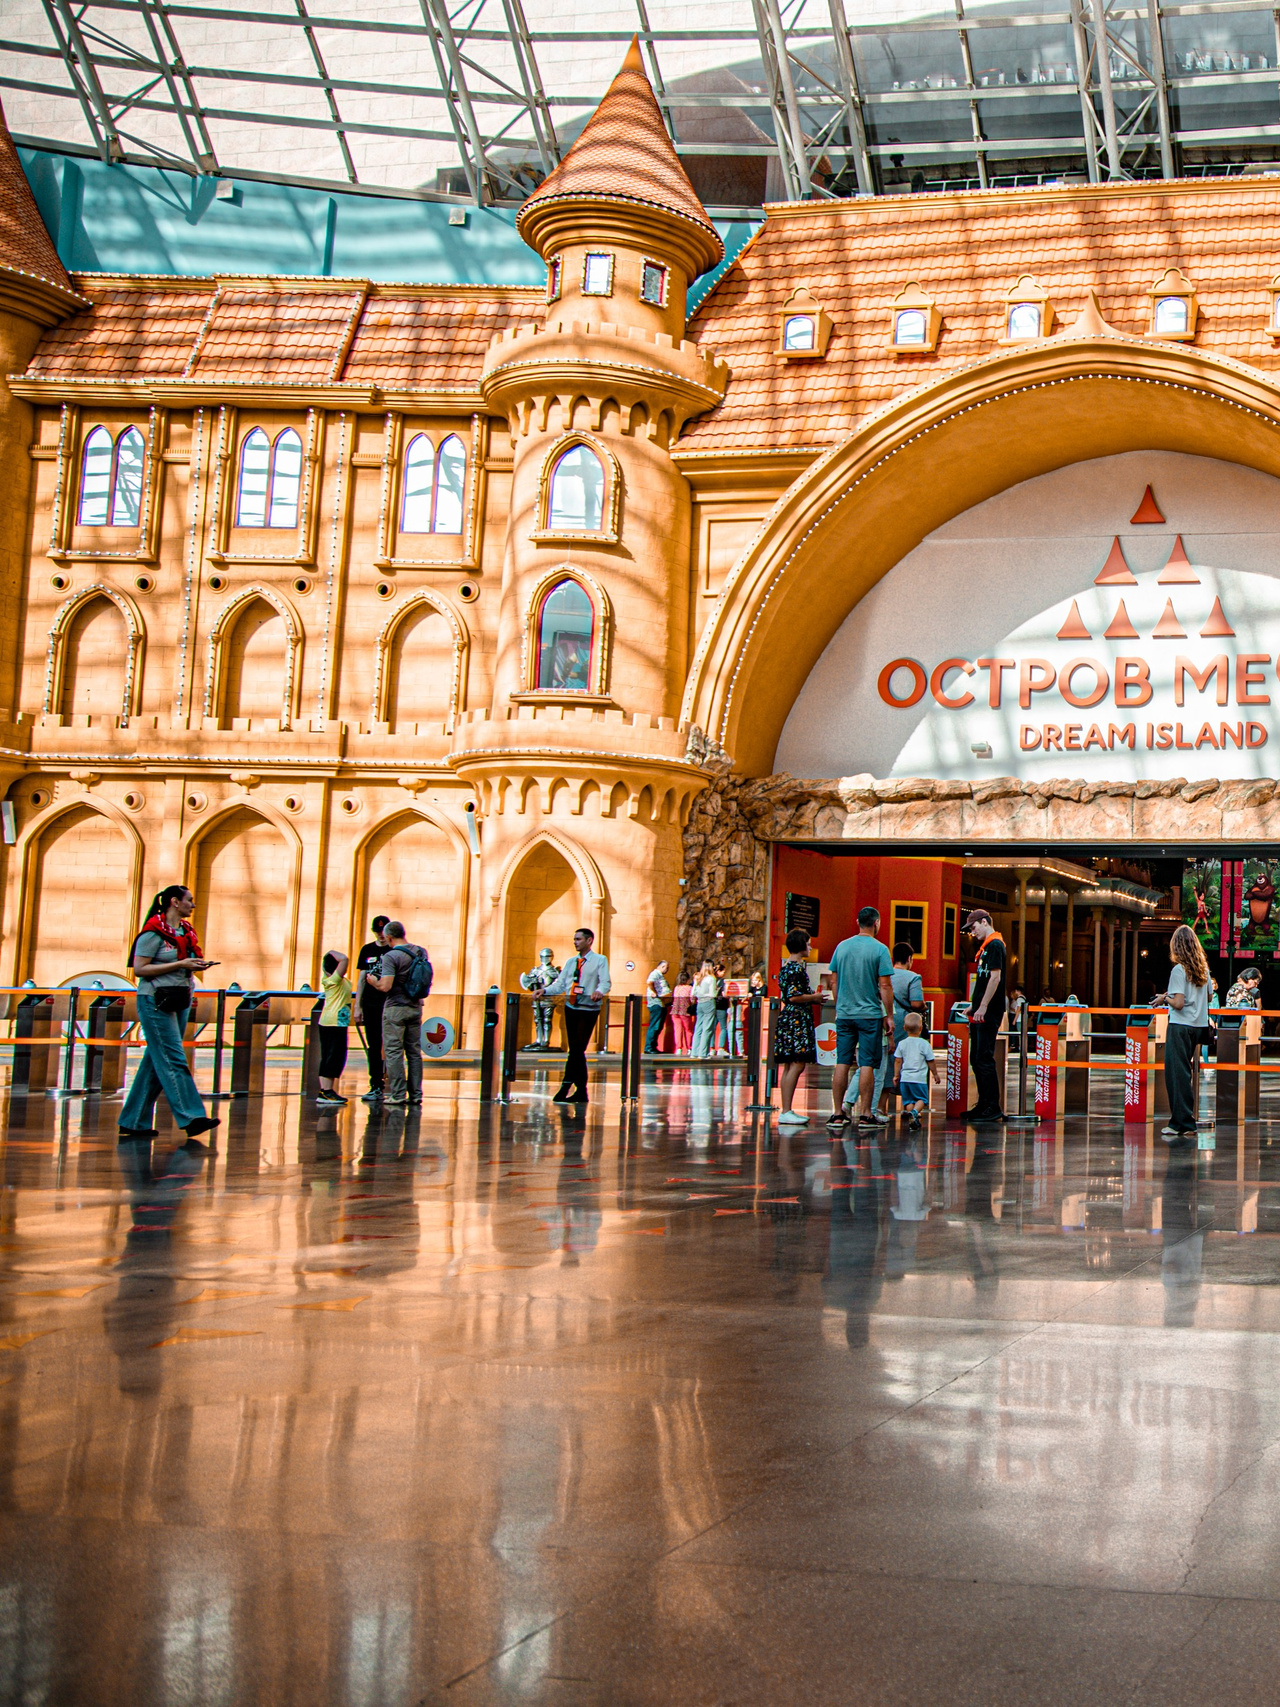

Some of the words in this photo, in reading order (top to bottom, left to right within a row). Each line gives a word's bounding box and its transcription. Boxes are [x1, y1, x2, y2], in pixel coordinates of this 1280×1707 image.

[877, 656, 1153, 708] ОСТРОВ
[1019, 722, 1136, 751] DREAM
[1146, 721, 1268, 750] ISLAND
[947, 1033, 956, 1091] FASTPASS
